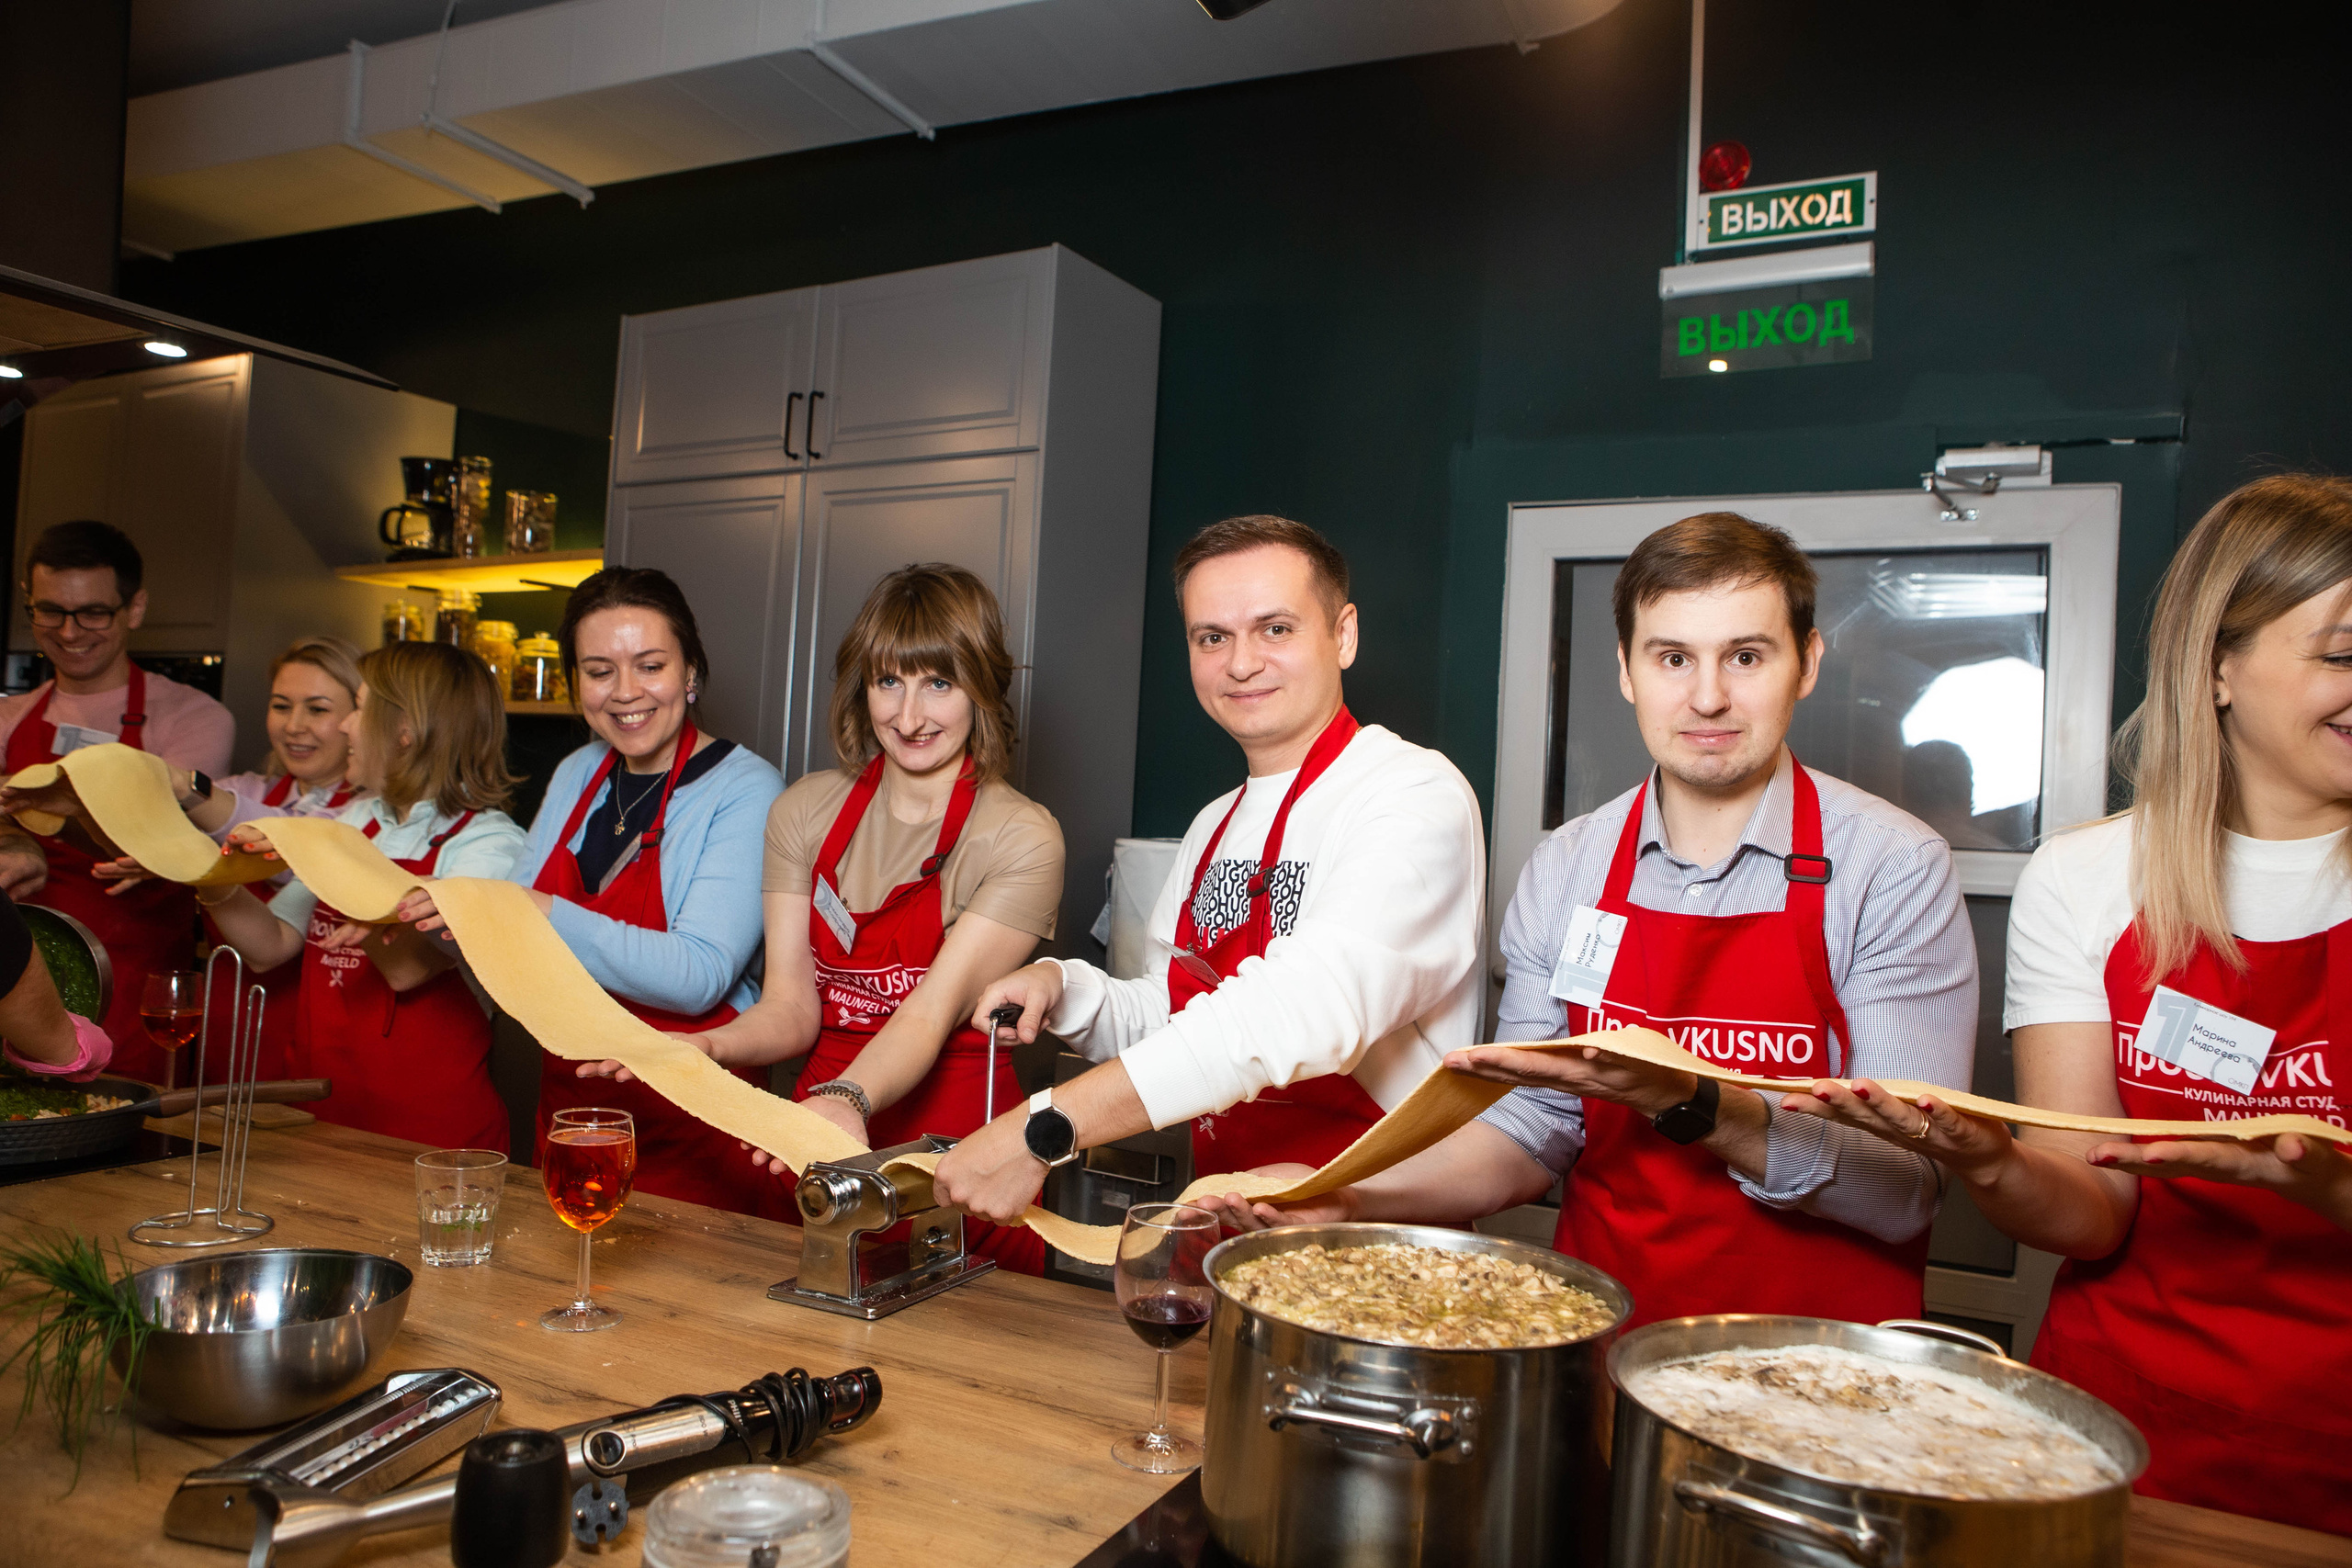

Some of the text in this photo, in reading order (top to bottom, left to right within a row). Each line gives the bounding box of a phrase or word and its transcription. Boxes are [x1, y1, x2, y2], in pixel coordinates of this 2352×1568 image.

[1721, 188, 1852, 236] ВЫХОД
[1678, 298, 1855, 356] ВЫХОД
[1576, 932, 1591, 965] Максим
[1585, 933, 1601, 968] Руденко
[2187, 1035, 2241, 1064] Андреева
[2192, 1022, 2237, 1048] Марина
[2183, 1087, 2292, 1109] КУЛИНАРНАЯ
